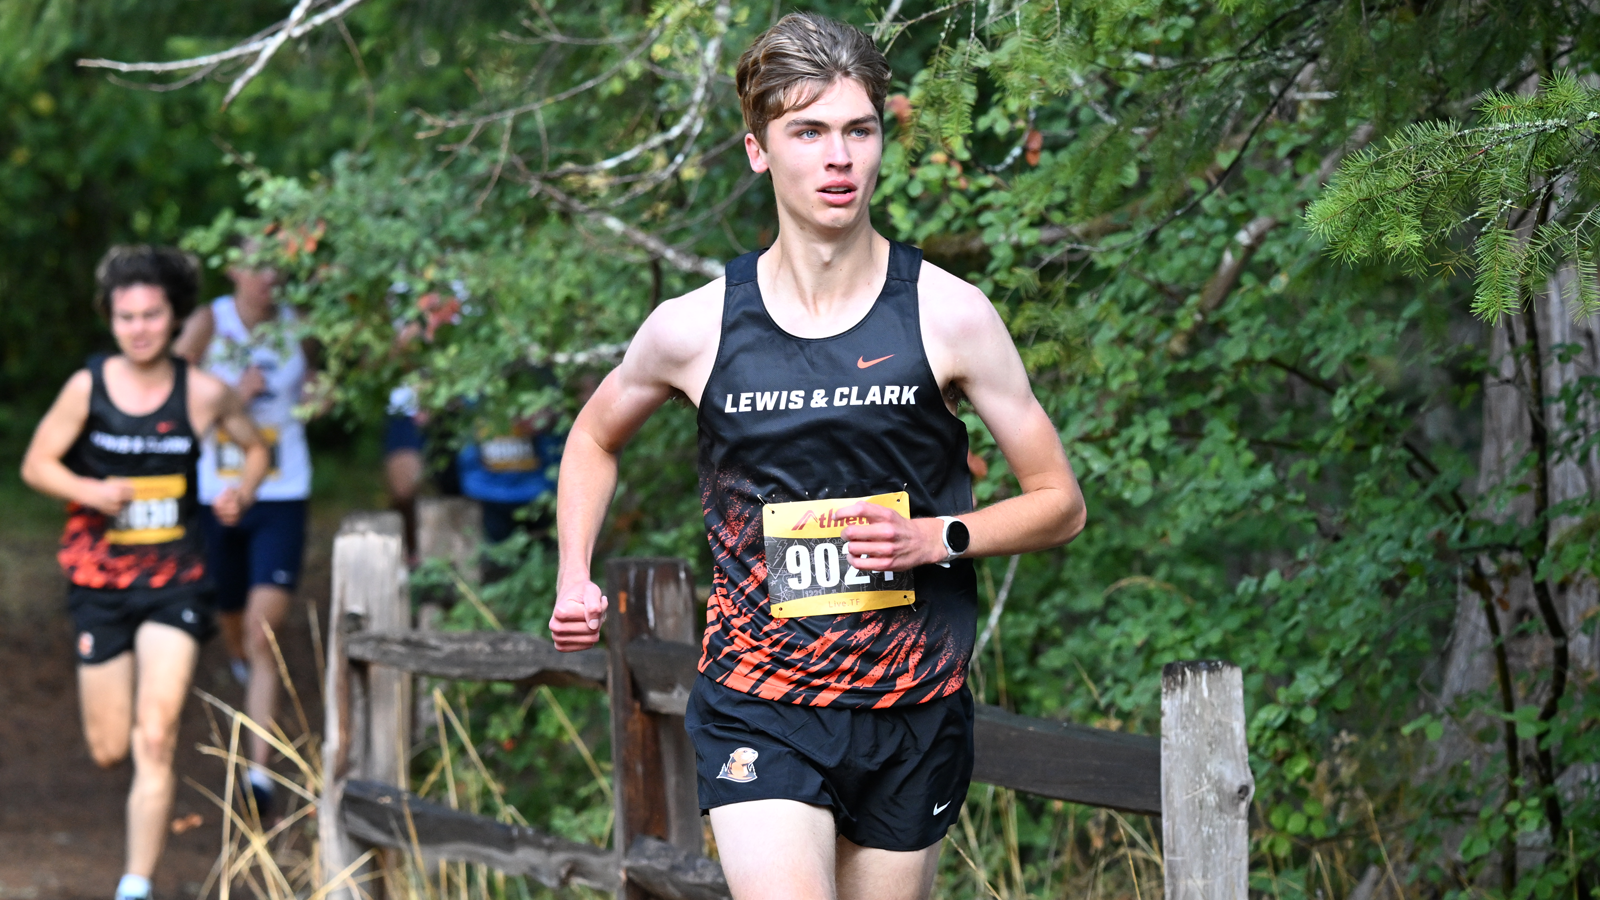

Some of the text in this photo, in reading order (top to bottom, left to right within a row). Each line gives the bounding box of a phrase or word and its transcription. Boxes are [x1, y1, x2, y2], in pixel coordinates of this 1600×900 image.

[724, 385, 919, 413] LEWIS & CLARK
[786, 542, 894, 590] 902
[828, 598, 861, 609] Live.TF
